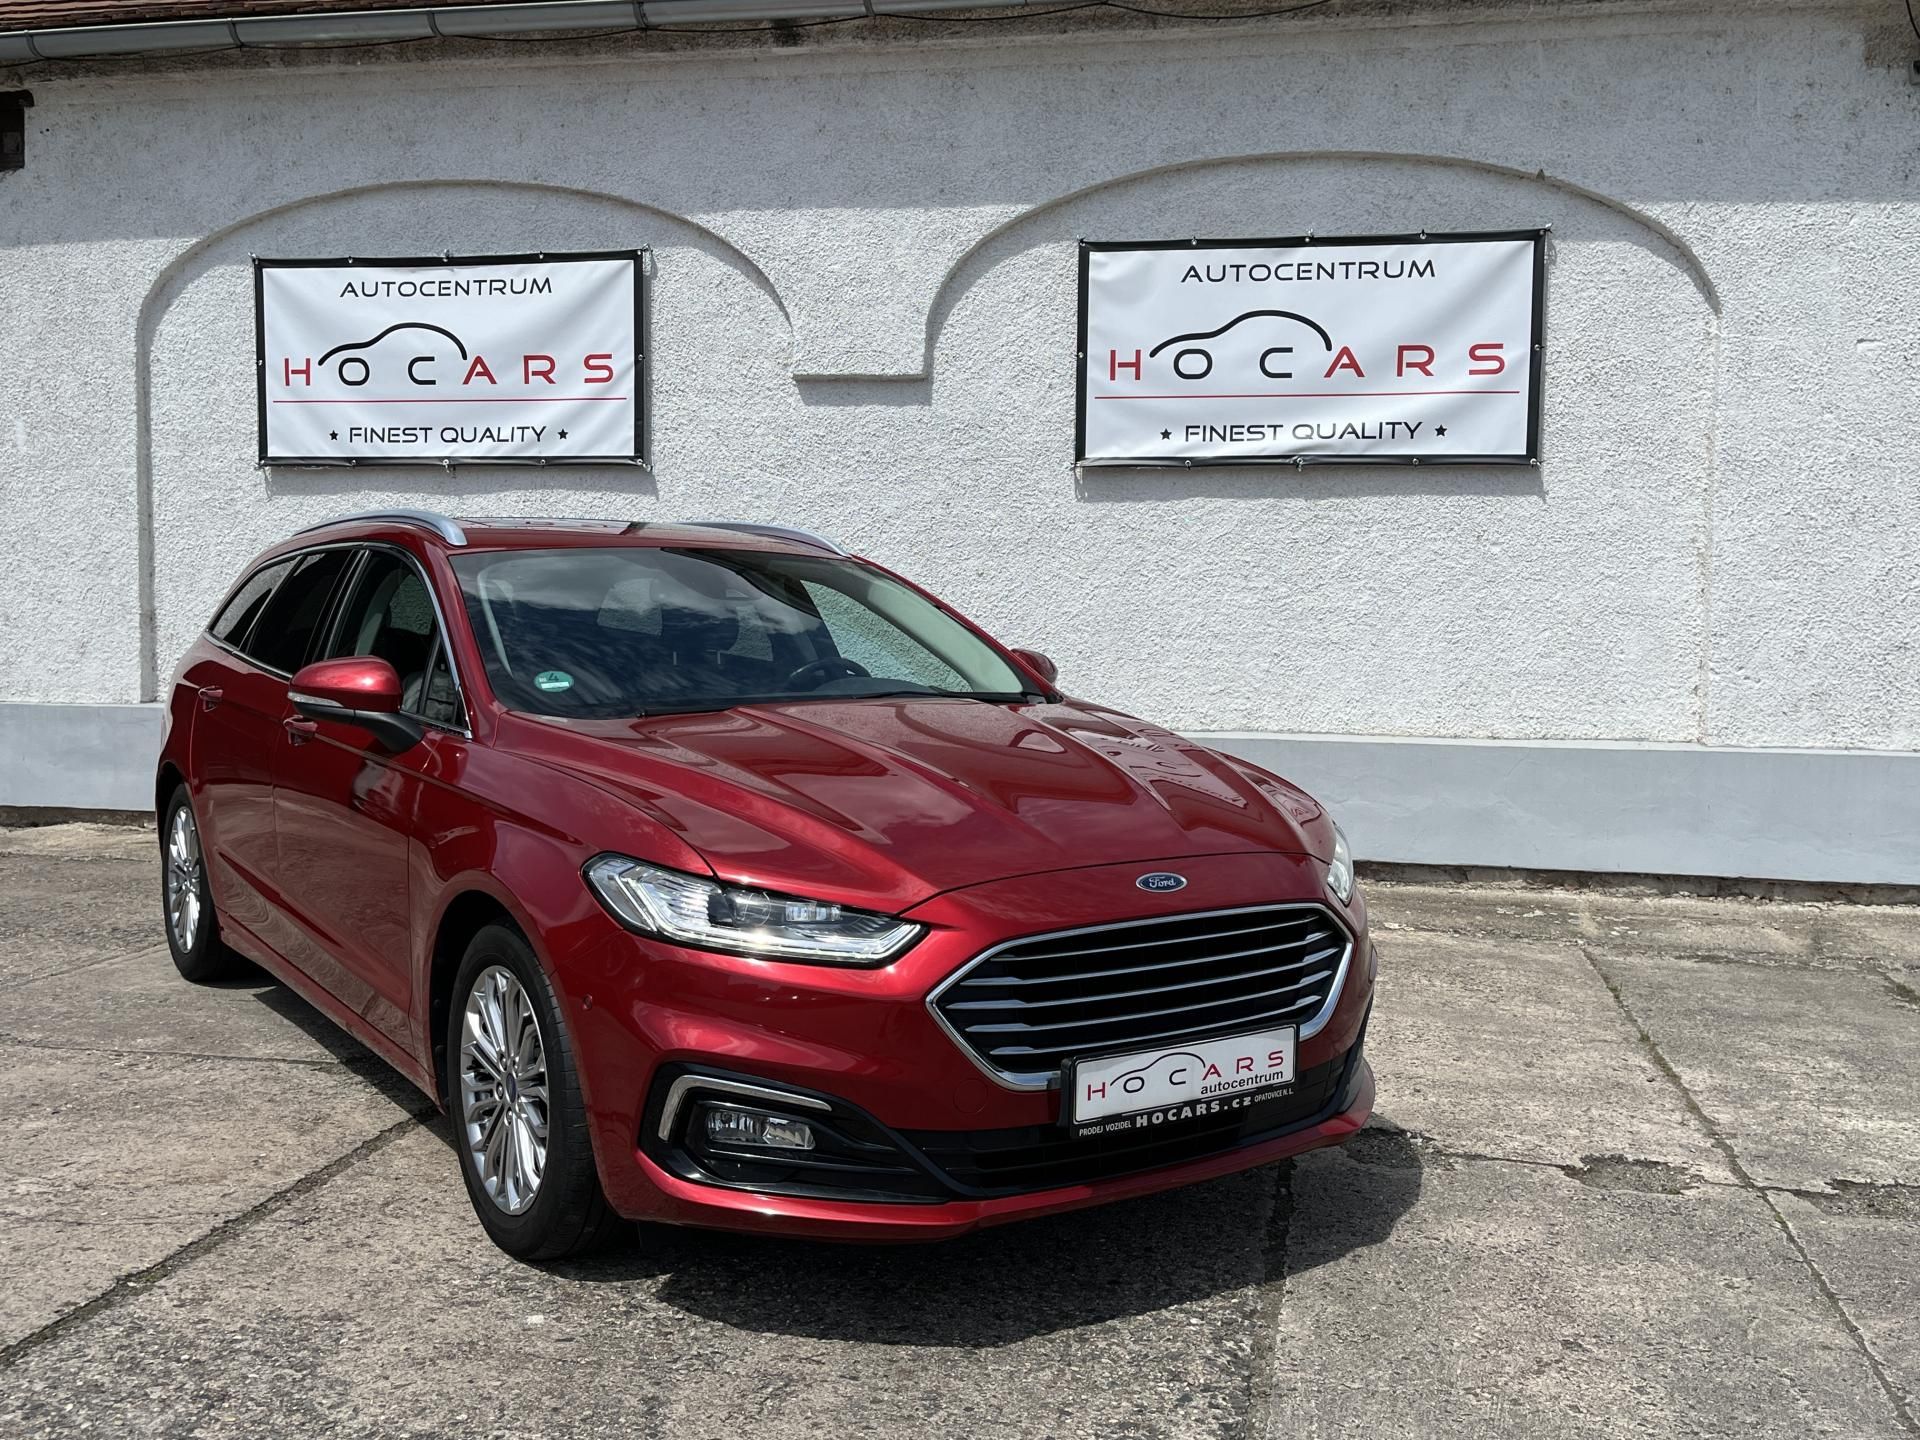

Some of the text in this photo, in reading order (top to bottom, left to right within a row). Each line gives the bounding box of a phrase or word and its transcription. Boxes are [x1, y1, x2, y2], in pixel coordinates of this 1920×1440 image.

[1181, 259, 1435, 283] AUTOCENTRUM
[340, 277, 552, 298] AUTOCENTRUM
[349, 426, 547, 444] FINEST QUALITY
[1185, 422, 1423, 442] FINEST QUALITY
[1148, 876, 1177, 888] Ford
[1200, 1070, 1283, 1096] autocentrum
[1079, 1125, 1104, 1136] PRODEJ
[1106, 1120, 1132, 1131] VOZIDEL
[1254, 1089, 1282, 1102] OPATOVICE
